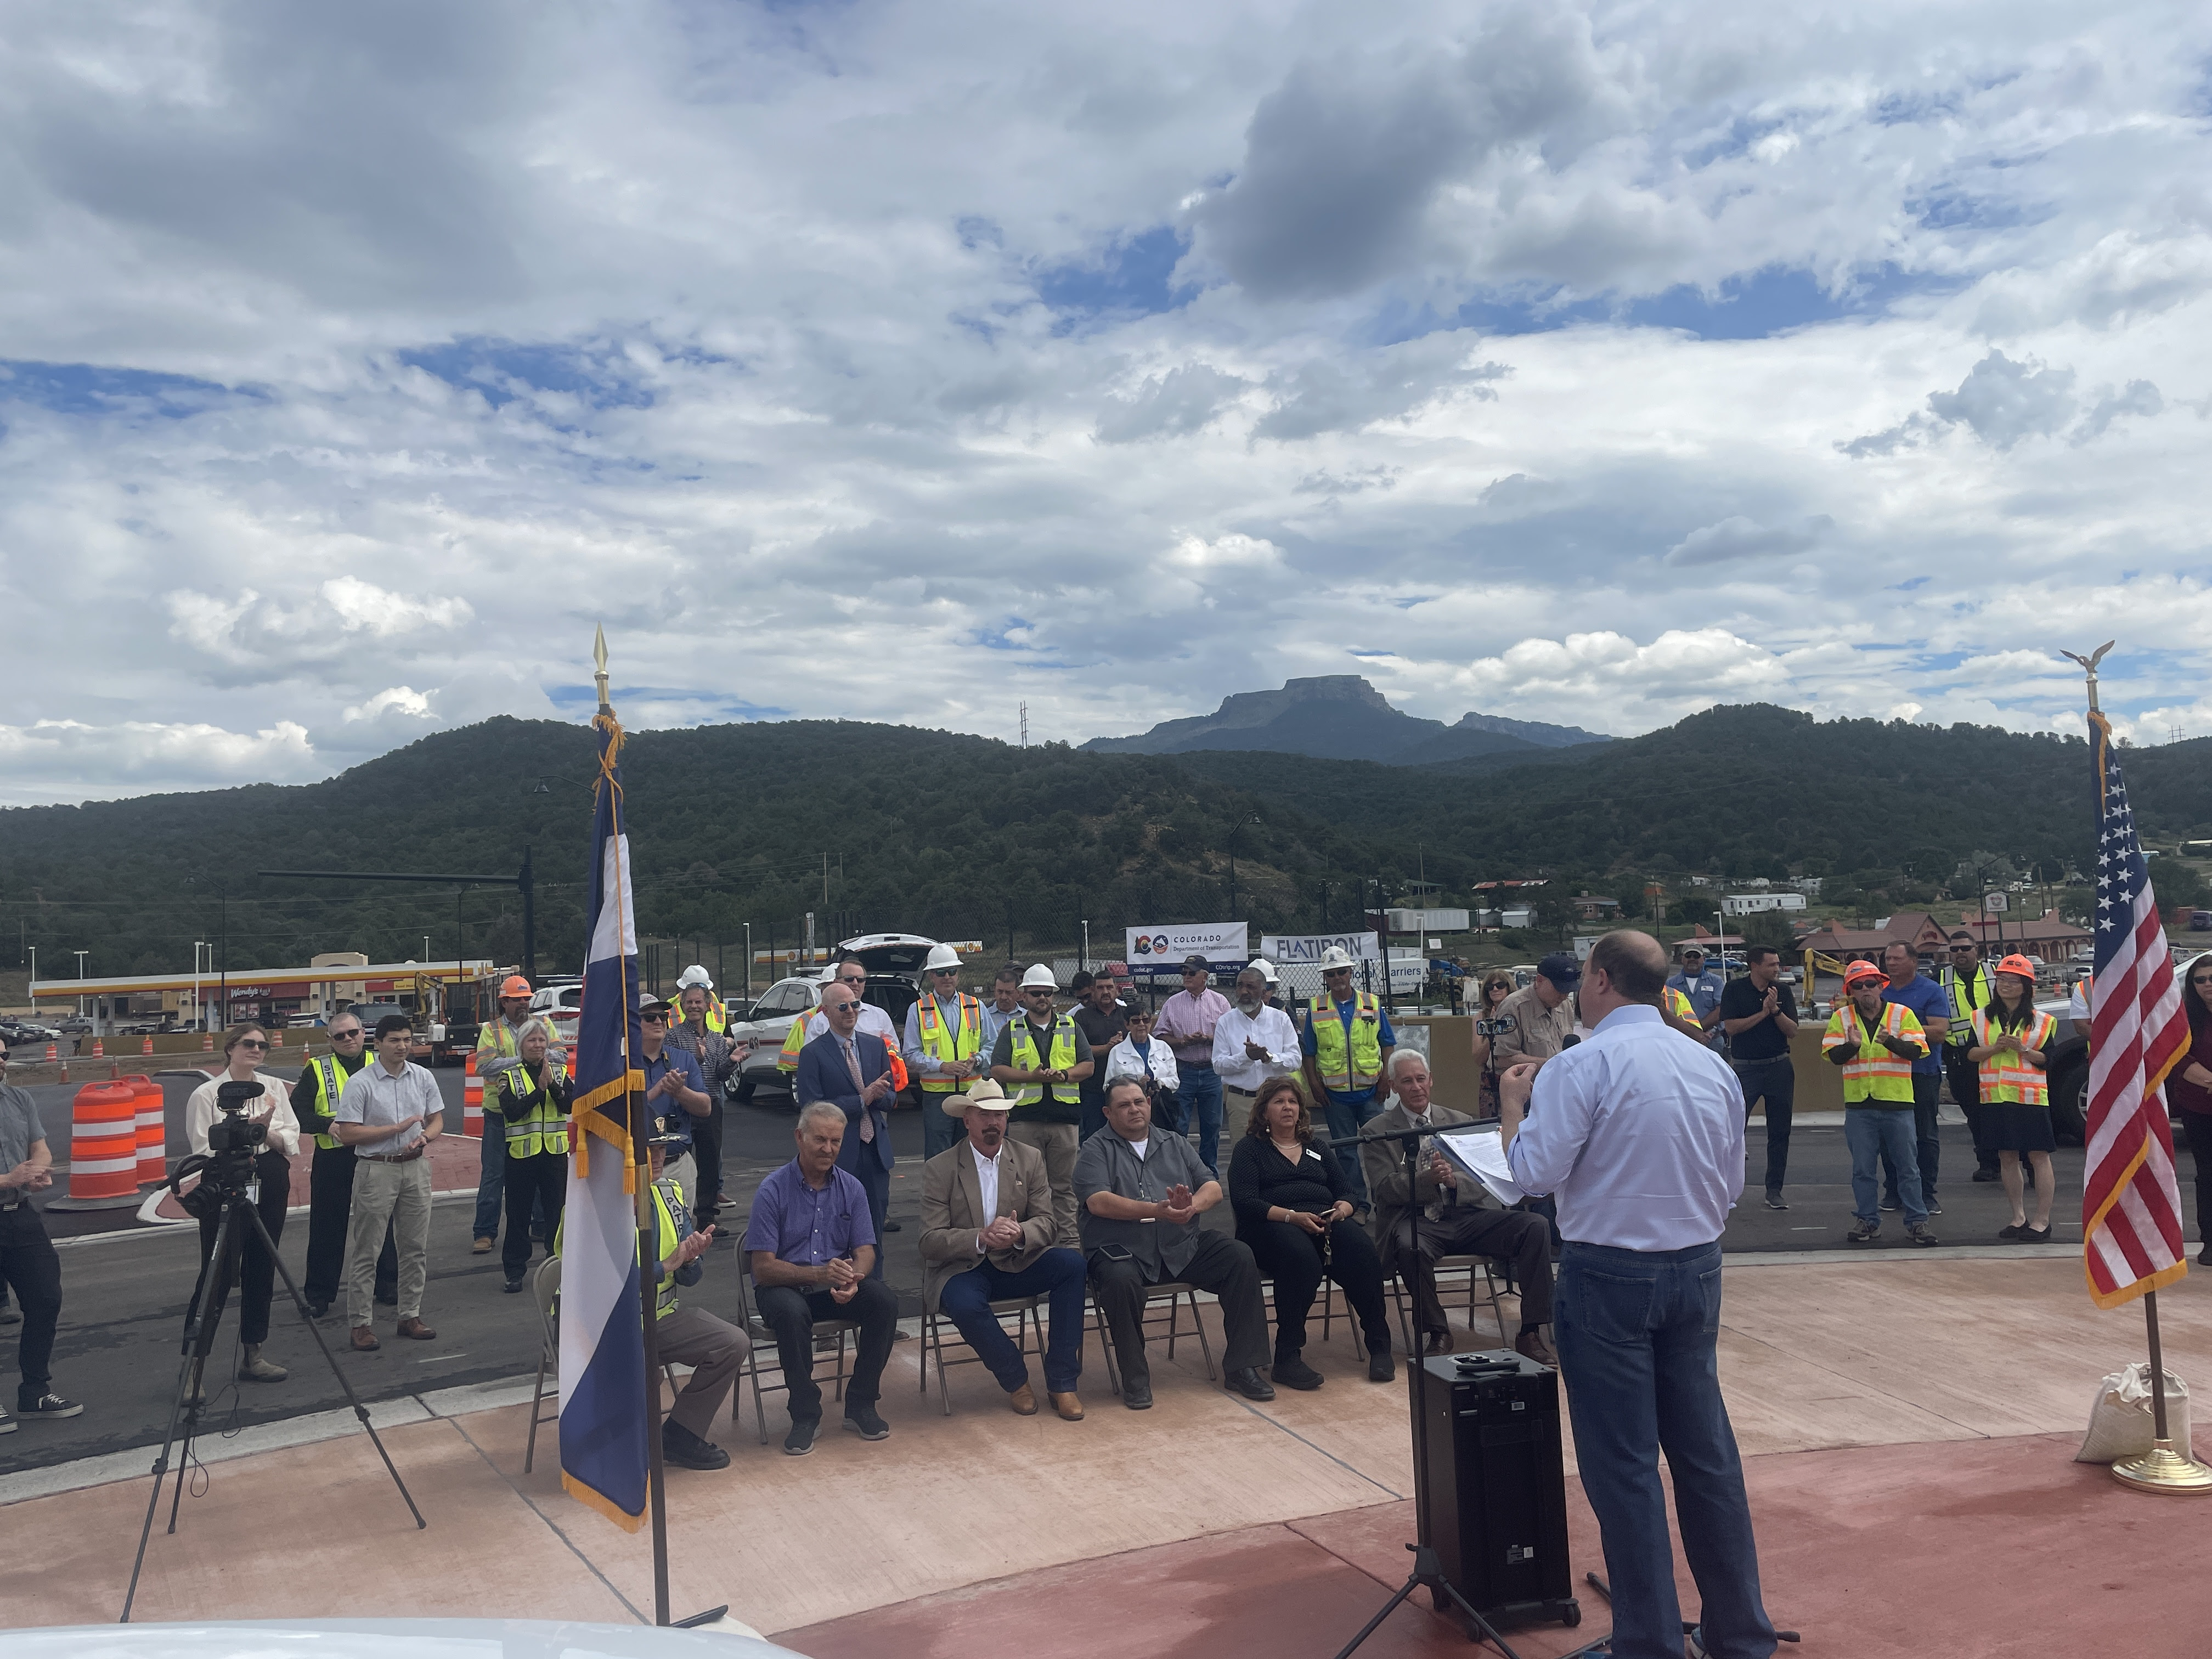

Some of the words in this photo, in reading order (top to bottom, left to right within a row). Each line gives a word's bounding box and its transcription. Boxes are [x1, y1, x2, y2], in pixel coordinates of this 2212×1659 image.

[1173, 935, 1221, 943] COLORADO
[1390, 967, 1421, 977] arriers
[230, 986, 259, 998] Wendy's
[324, 1065, 336, 1100] STATE
